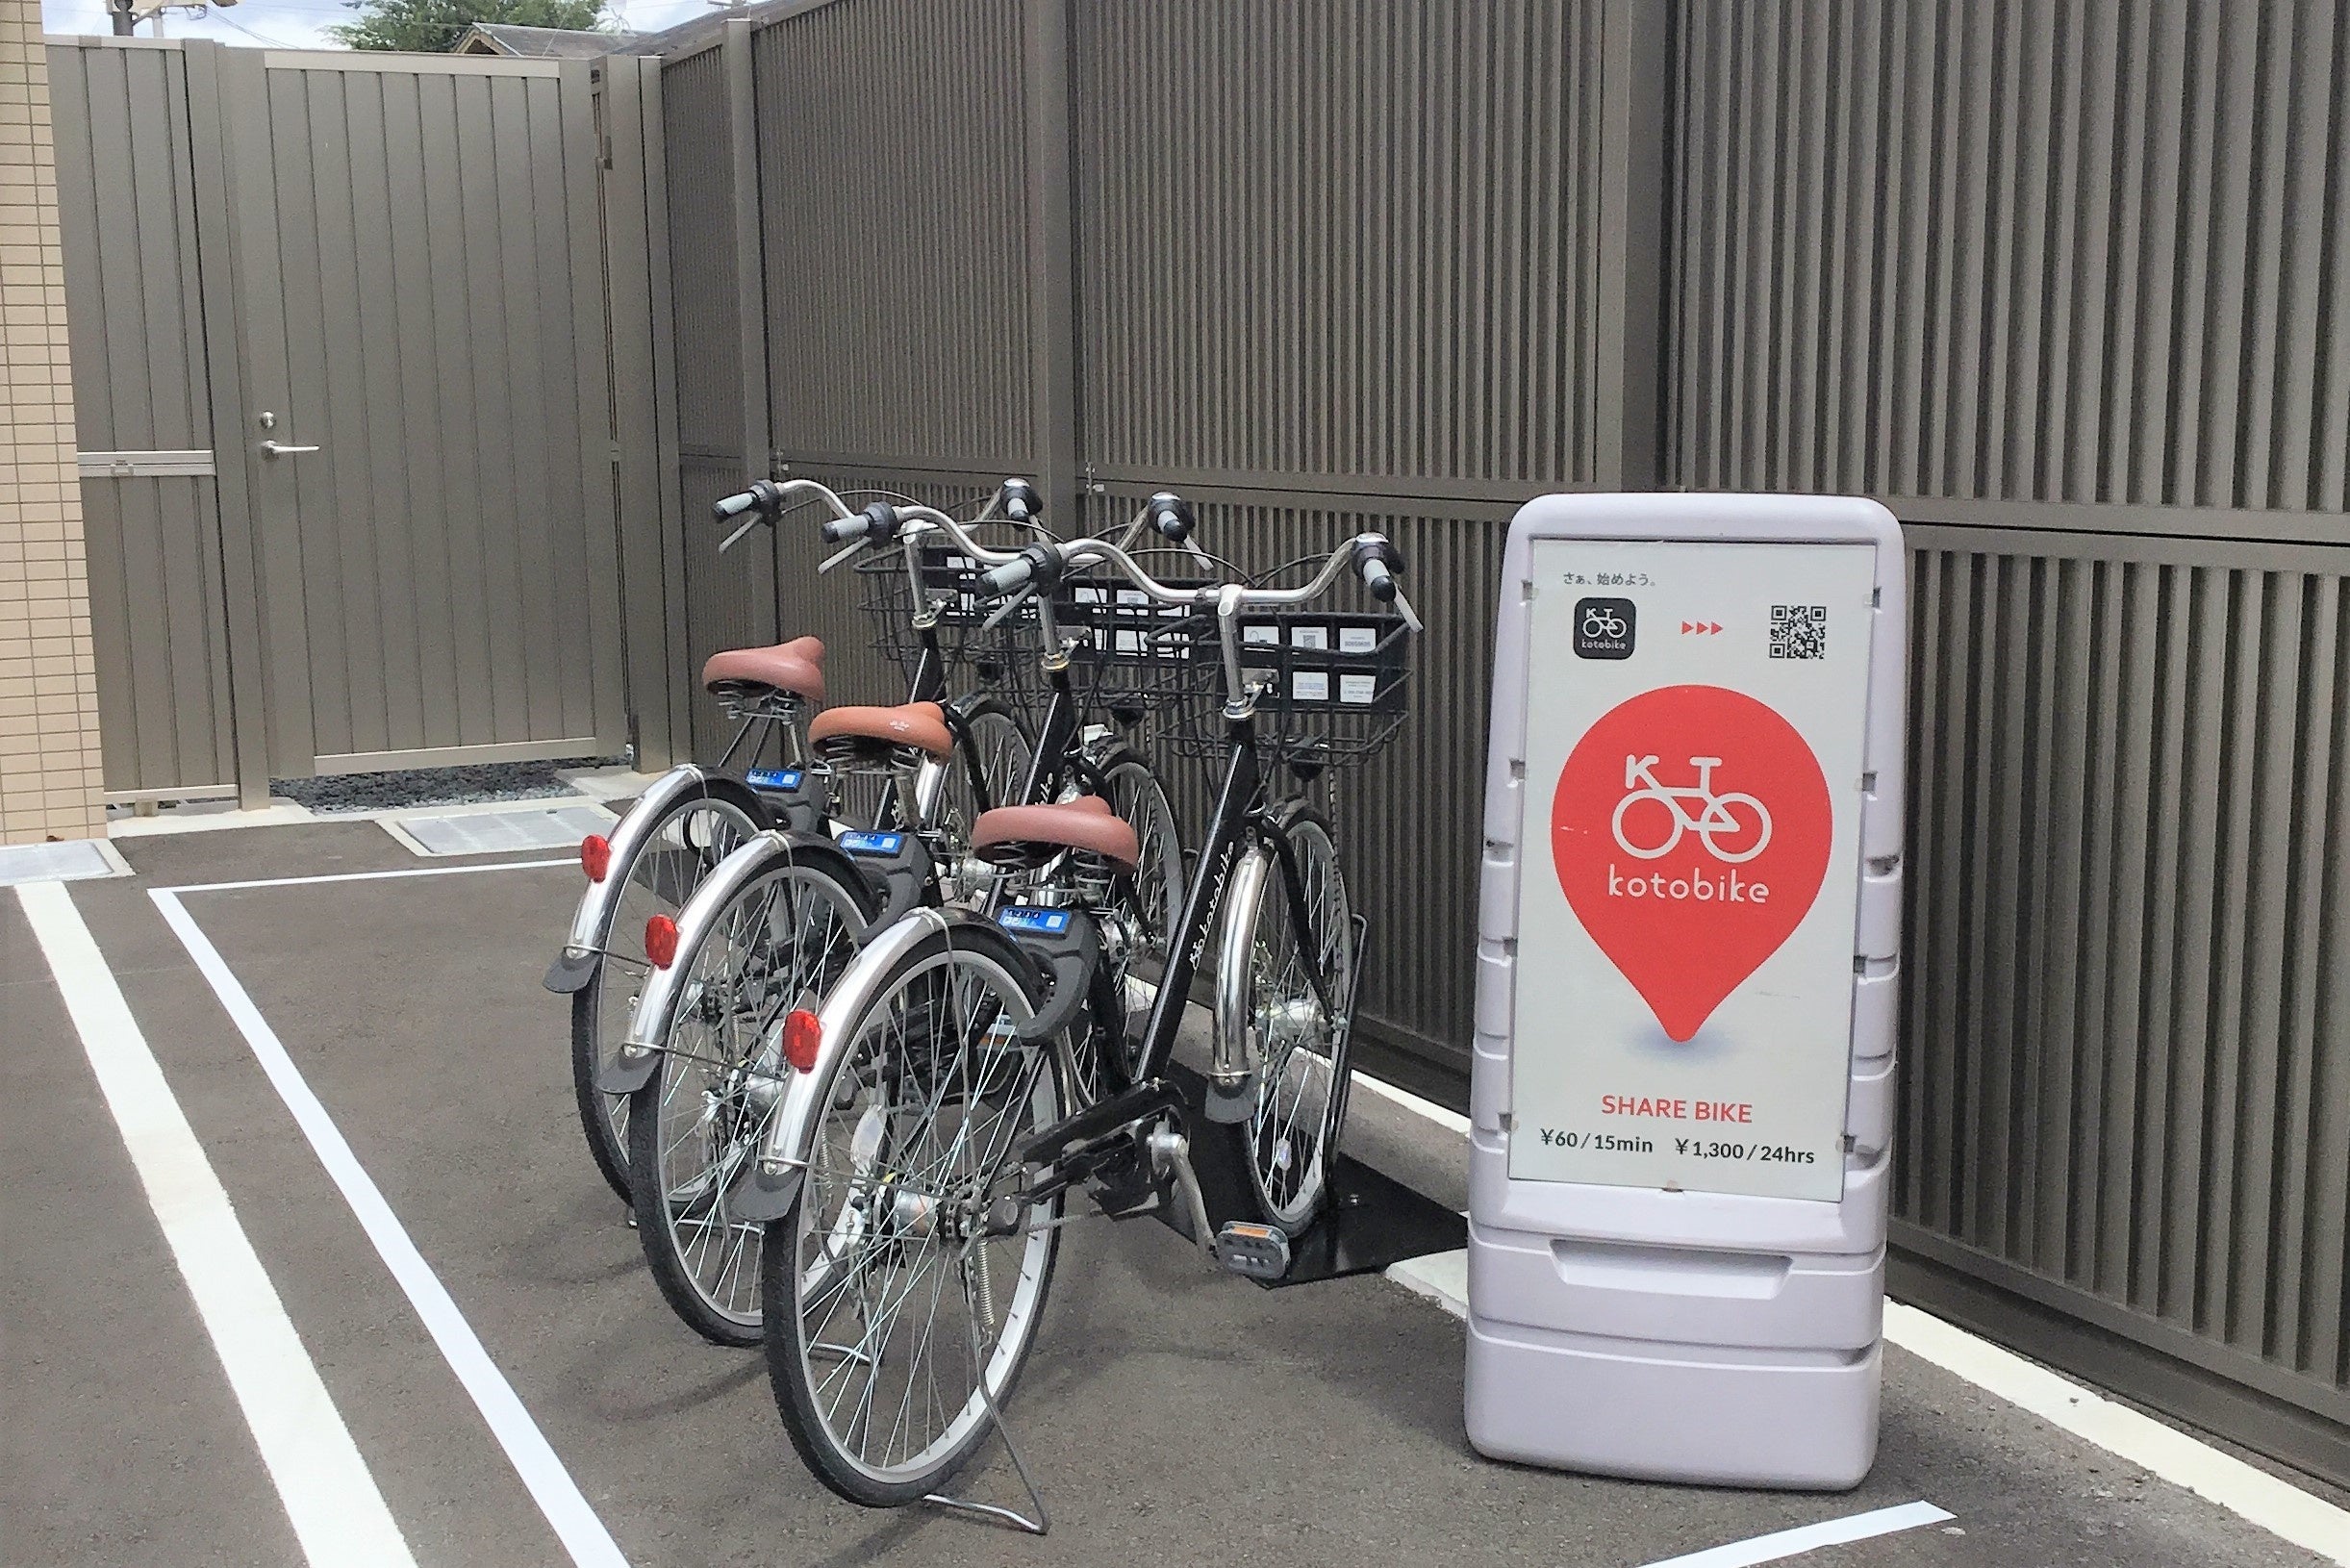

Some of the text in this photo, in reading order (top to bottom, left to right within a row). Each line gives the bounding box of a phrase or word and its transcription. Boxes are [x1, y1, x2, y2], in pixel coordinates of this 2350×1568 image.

[1563, 571, 1655, 586] さぁ、始めよう。
[1581, 639, 1627, 650] kotobike
[1608, 863, 1770, 903] kotobike
[1602, 1095, 1753, 1125] SHARE BIKE
